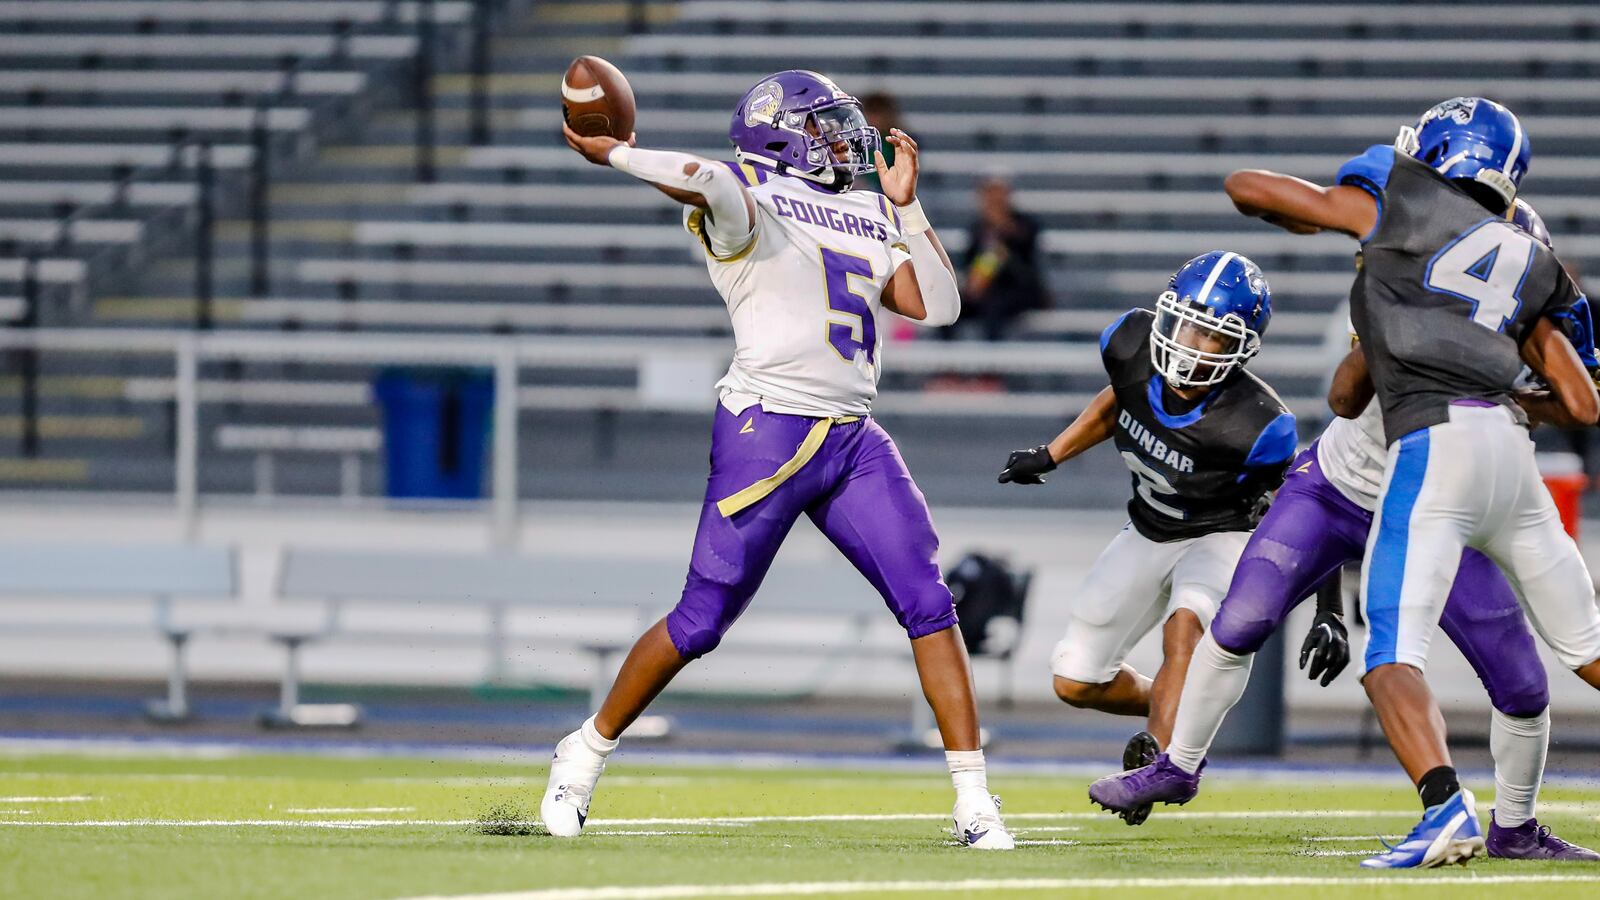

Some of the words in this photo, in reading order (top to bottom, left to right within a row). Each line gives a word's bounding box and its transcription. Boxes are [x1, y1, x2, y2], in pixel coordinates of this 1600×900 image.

[771, 194, 888, 242] COUGARS
[818, 243, 876, 364] 5
[1423, 217, 1537, 333] 4
[1118, 408, 1195, 473] DUNBAR
[1121, 450, 1186, 520] 2
